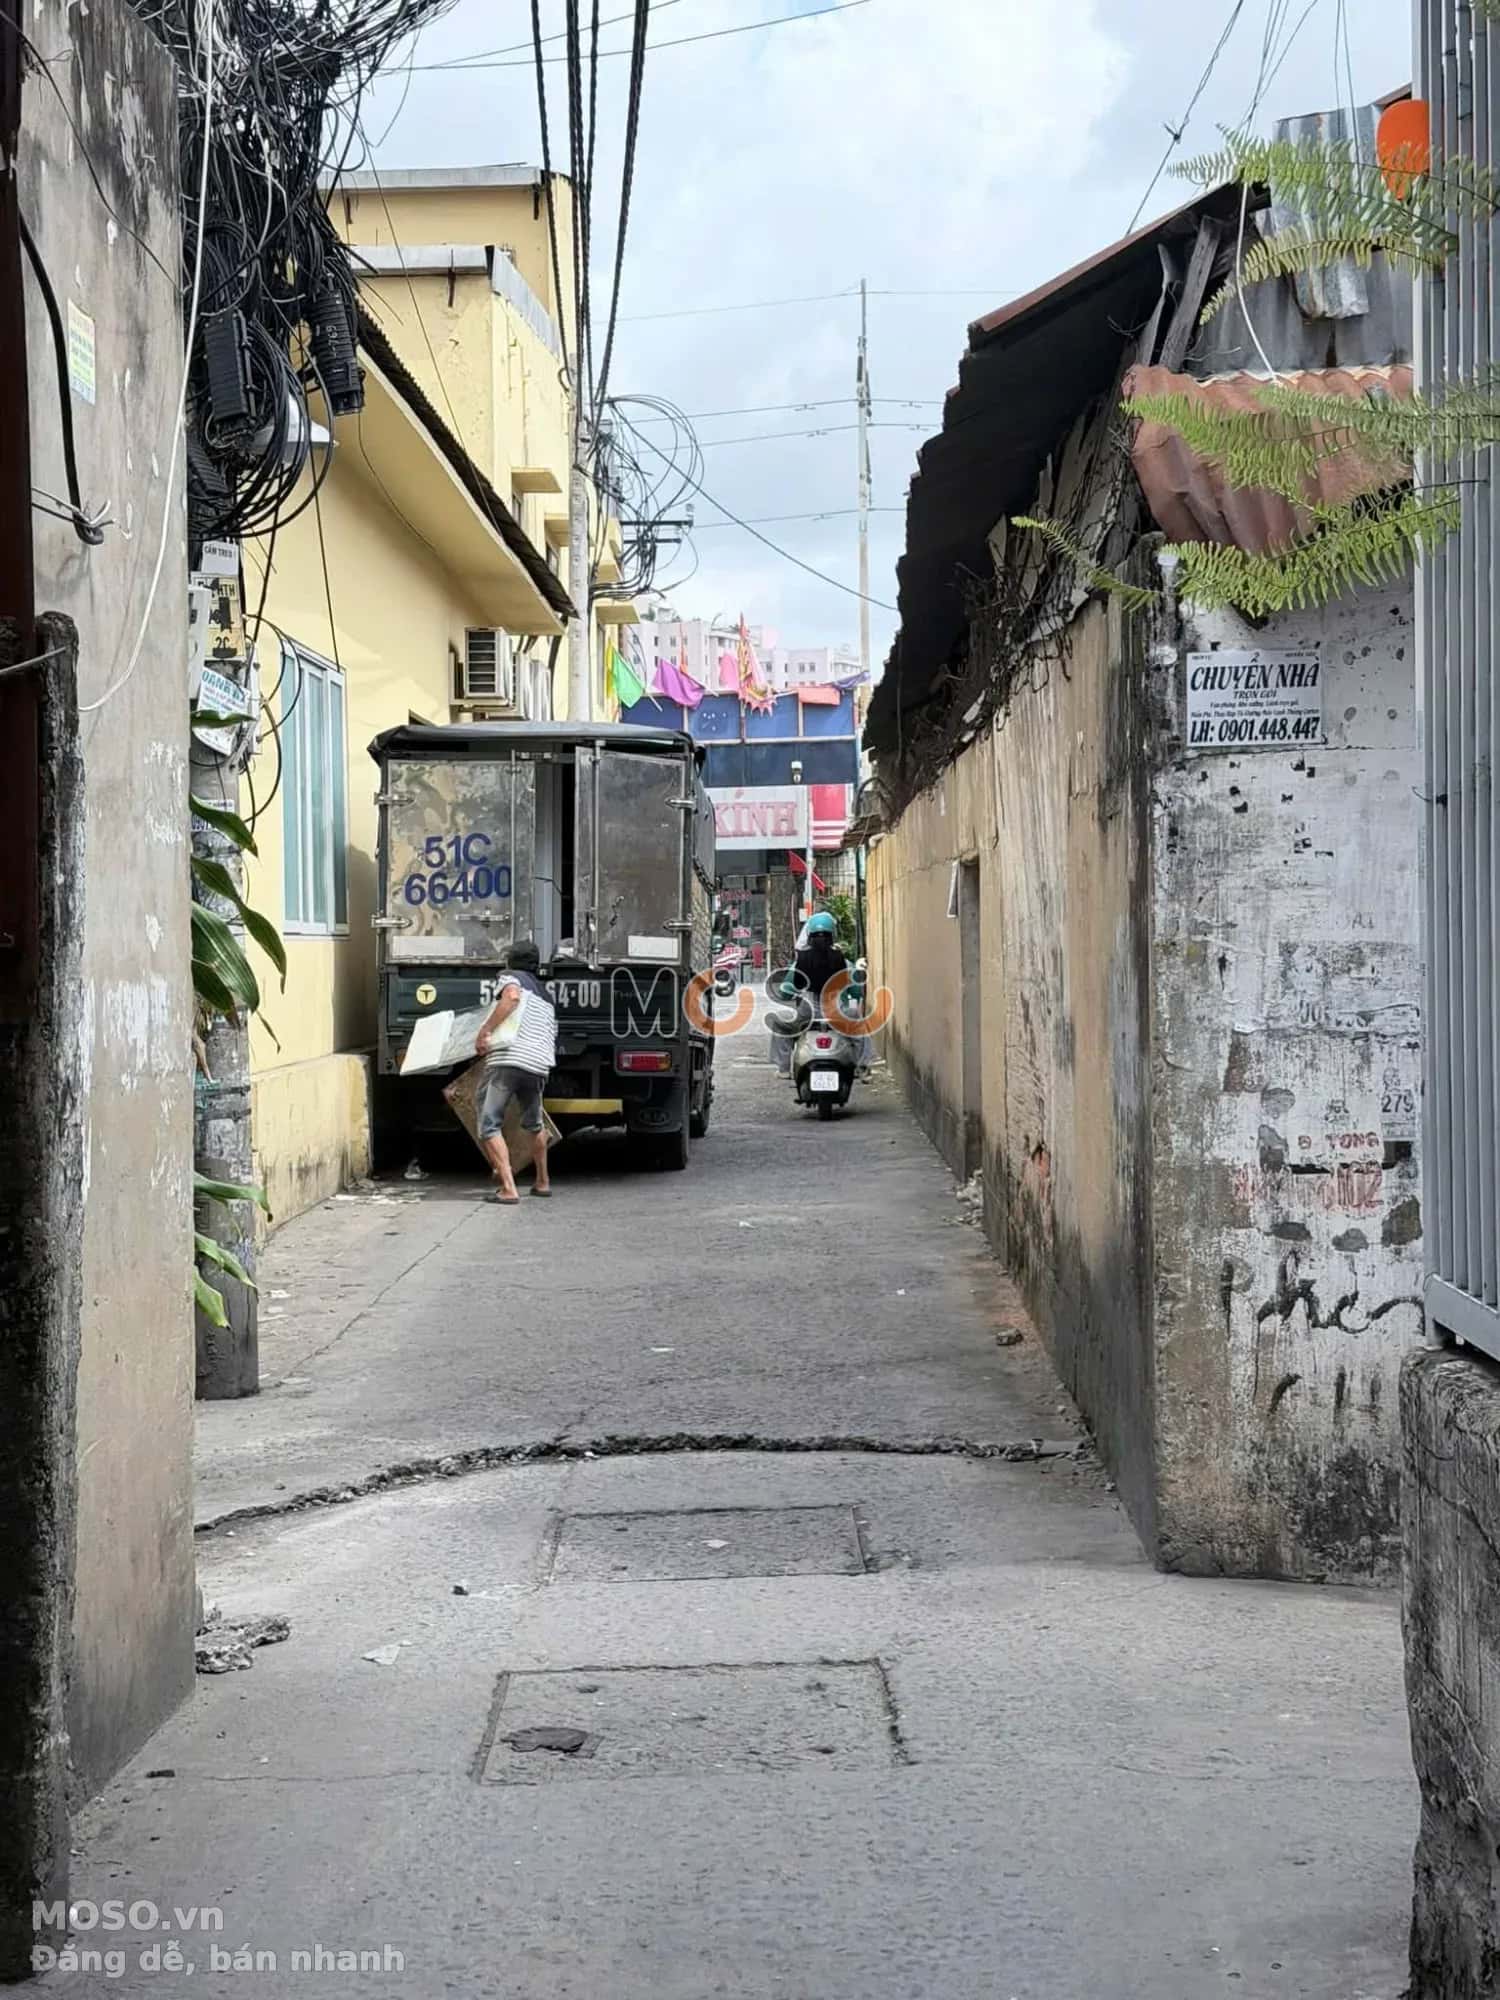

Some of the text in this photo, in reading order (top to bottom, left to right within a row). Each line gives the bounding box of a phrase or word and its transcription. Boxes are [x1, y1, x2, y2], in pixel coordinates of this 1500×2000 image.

[1190, 652, 1320, 691] CHUYỂN NHÀ
[1190, 716, 1320, 743] LH: 0901.448.447
[425, 833, 491, 868] 51C
[404, 865, 511, 906] 66400
